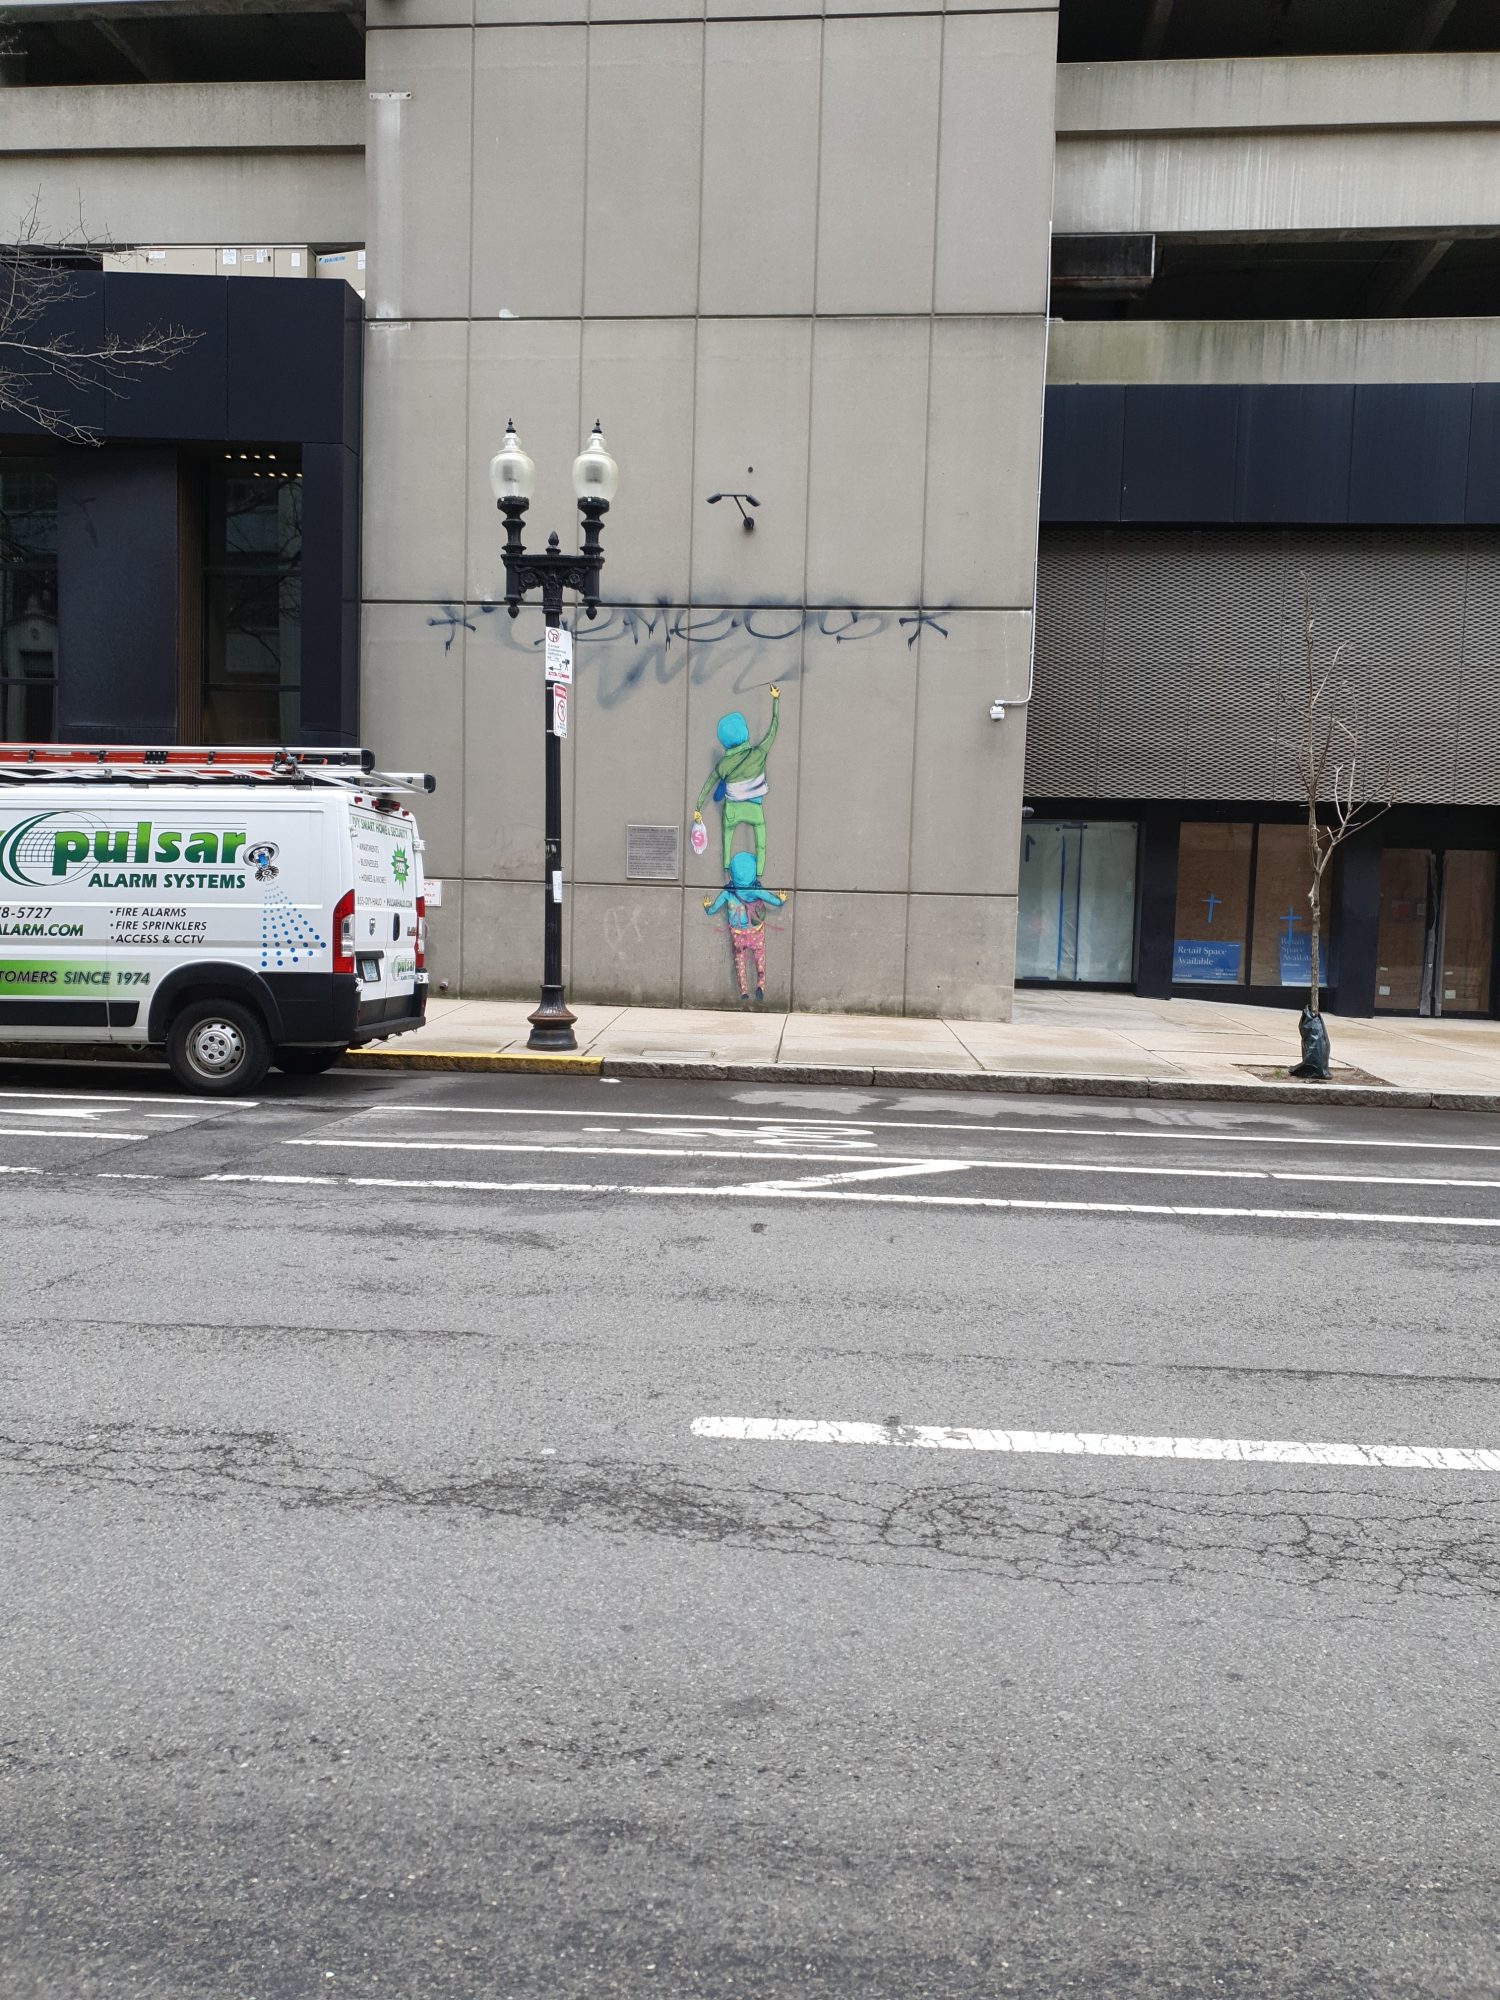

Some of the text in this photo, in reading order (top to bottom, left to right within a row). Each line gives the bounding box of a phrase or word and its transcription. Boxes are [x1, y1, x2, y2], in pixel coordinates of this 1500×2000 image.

[52, 822, 246, 876] pulsar
[88, 873, 246, 889] ALARM SYSTEMS
[115, 907, 187, 917] FIRE ALARMS
[115, 920, 207, 931] FIRE SPRINKLERS
[115, 934, 205, 944] ACCESS & CCTV
[1178, 946, 1228, 957] Retail Space
[1178, 957, 1214, 966] Available
[64, 971, 111, 984] SINCE
[117, 972, 151, 985] 1974
